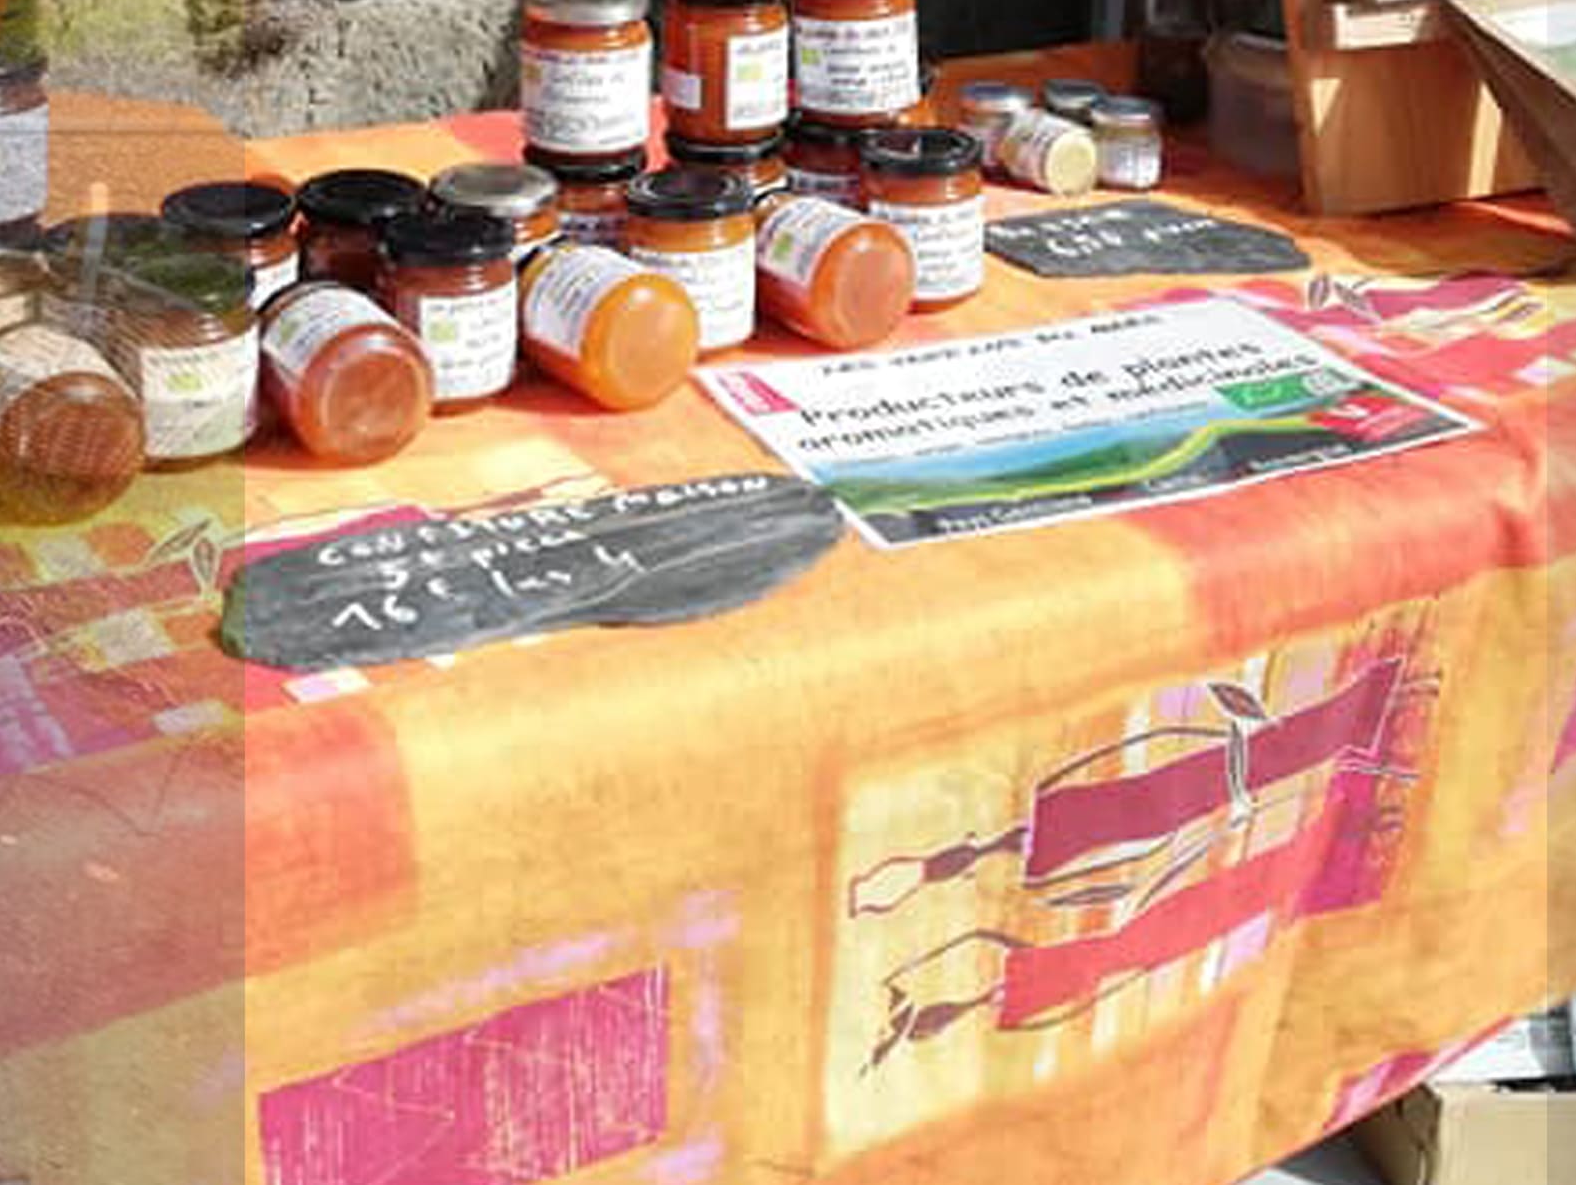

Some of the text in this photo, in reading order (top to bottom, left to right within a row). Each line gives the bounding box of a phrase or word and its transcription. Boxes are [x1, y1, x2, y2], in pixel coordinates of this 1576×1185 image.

[800, 375, 1046, 426] Producteurs
[1060, 362, 1111, 393] de
[1123, 337, 1263, 381] plantes
[797, 402, 1036, 455] aromatiques
[1050, 391, 1095, 415] et
